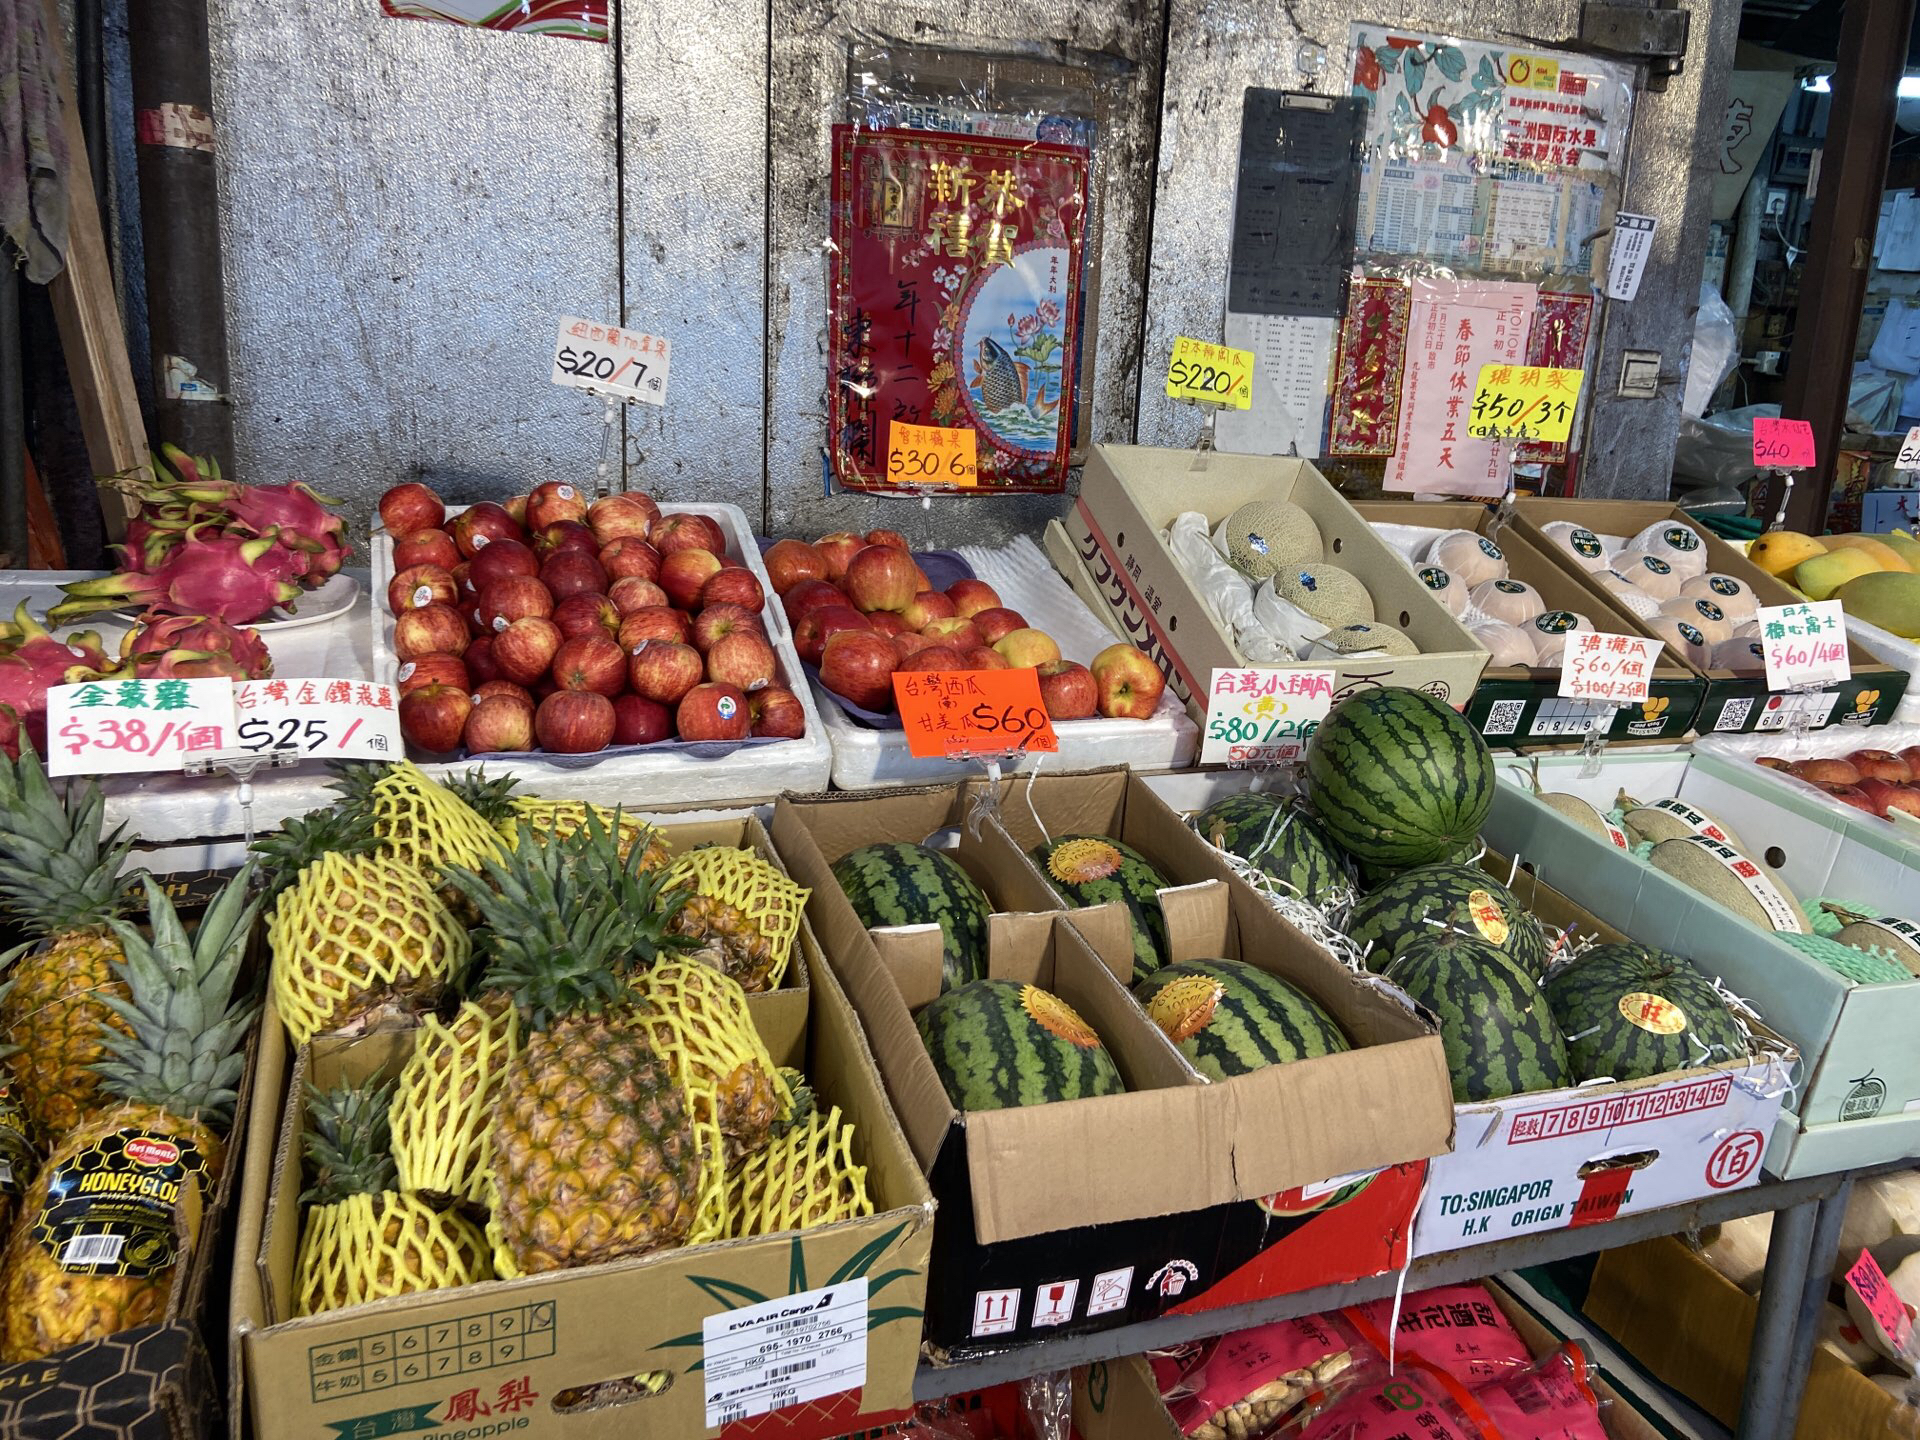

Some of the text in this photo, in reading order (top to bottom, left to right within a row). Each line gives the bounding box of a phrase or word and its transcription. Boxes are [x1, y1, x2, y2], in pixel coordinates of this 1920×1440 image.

[1436, 318, 1475, 469] 春節休業五天
[1754, 439, 1791, 460] $40
[972, 702, 1048, 733] $60
[1640, 1001, 1662, 1025] 旺
[1548, 1113, 1560, 1133] 7
[1567, 1110, 1580, 1130] 8
[1587, 1107, 1600, 1126] 9
[1627, 1099, 1643, 1119] 11
[1648, 1095, 1665, 1115] 12
[1668, 1091, 1686, 1110] 13
[1688, 1087, 1706, 1107] 14
[1709, 1082, 1726, 1102] 15
[145, 1146, 177, 1159] Monte
[1510, 1203, 1565, 1228] ORIGN
[1570, 1188, 1635, 1216] TAIWAN
[780, 1304, 814, 1319] Cargo
[371, 1341, 386, 1356] 5
[402, 1335, 418, 1350] 6
[436, 1328, 451, 1344] 7
[467, 1322, 482, 1338] 8
[500, 1316, 516, 1332] 9
[786, 1334, 812, 1348] 1970
[371, 1368, 388, 1384] 5
[403, 1362, 419, 1377] 6
[436, 1356, 452, 1371] 7
[468, 1350, 483, 1365] 8
[500, 1344, 516, 1359] 9
[744, 1356, 767, 1369] HKG
[442, 1375, 540, 1424] 鳳梨
[772, 1387, 796, 1400] HKG
[723, 1401, 744, 1413] TPE
